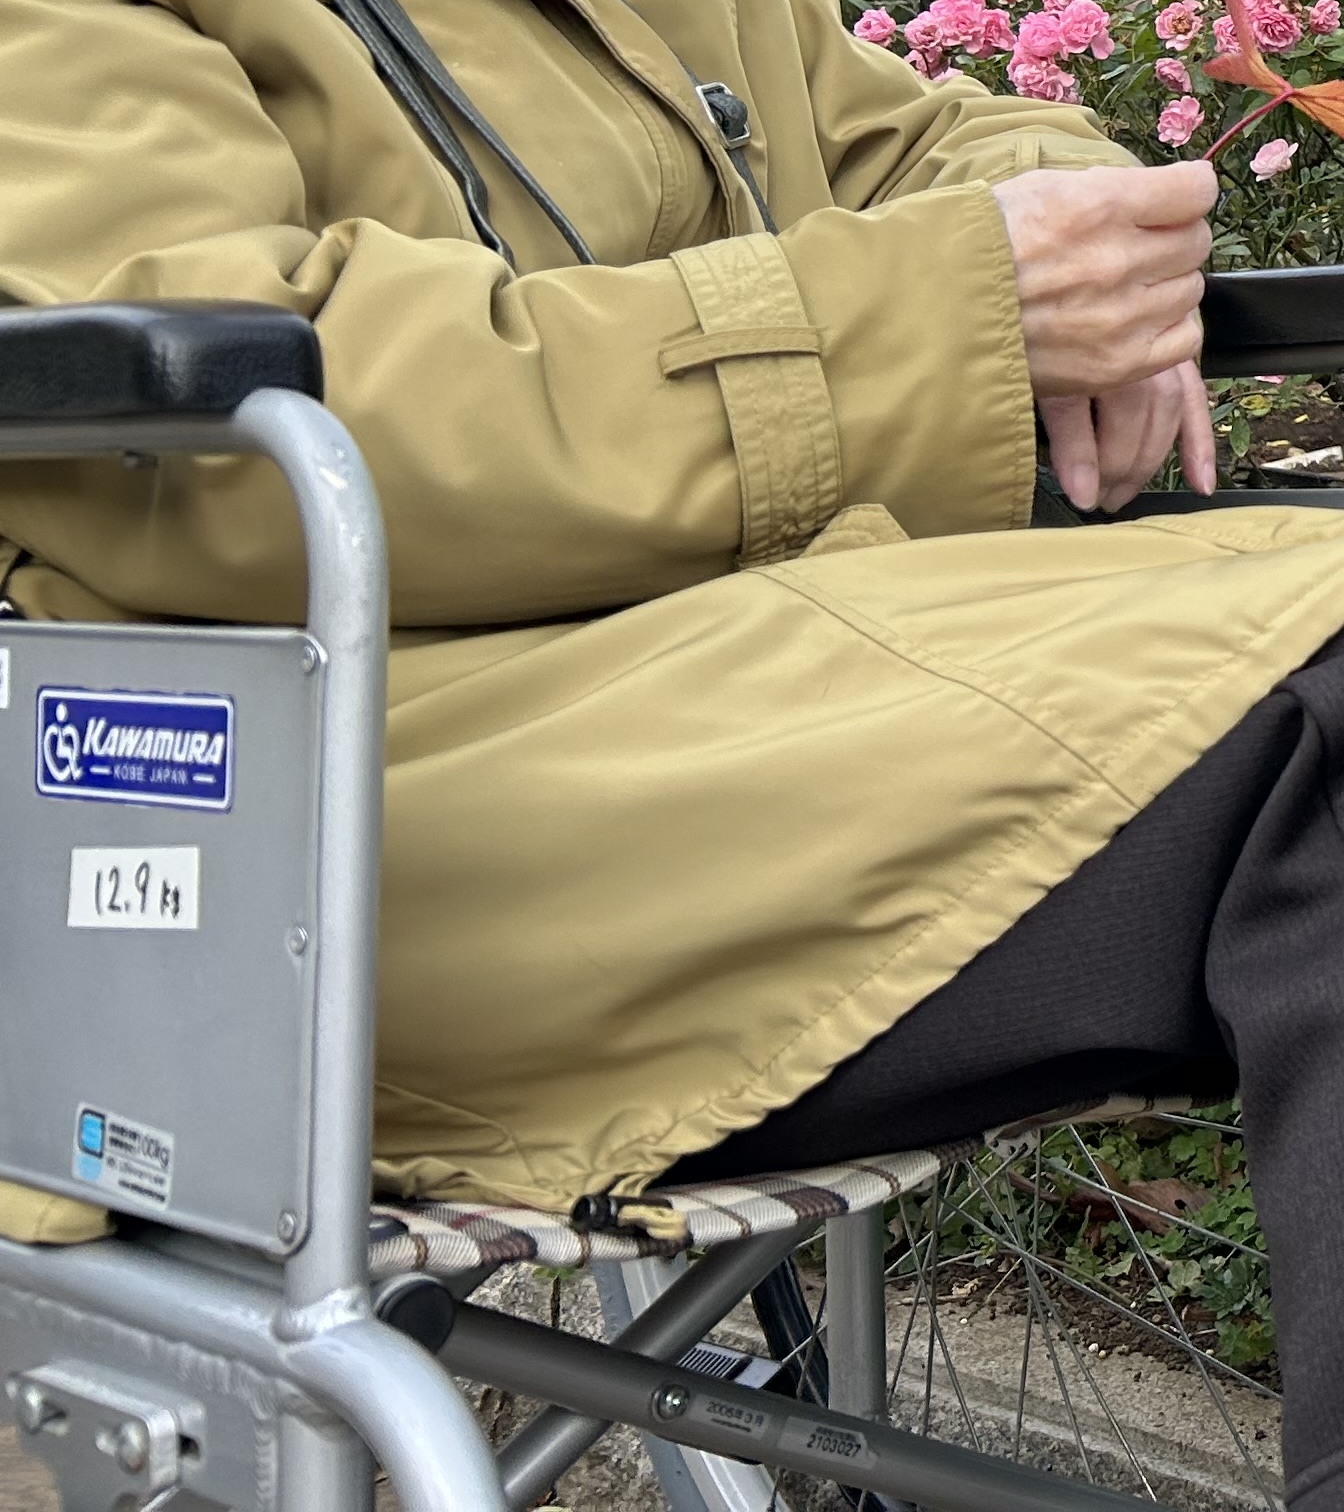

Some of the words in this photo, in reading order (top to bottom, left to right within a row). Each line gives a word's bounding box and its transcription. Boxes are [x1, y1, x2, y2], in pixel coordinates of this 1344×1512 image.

[83, 718, 224, 766] KAWAMURA
[113, 762, 147, 780] KOBE
[150, 766, 188, 784] JAPAN
[95, 860, 150, 915] 12.9
[807, 1434, 862, 1458] 2103027
